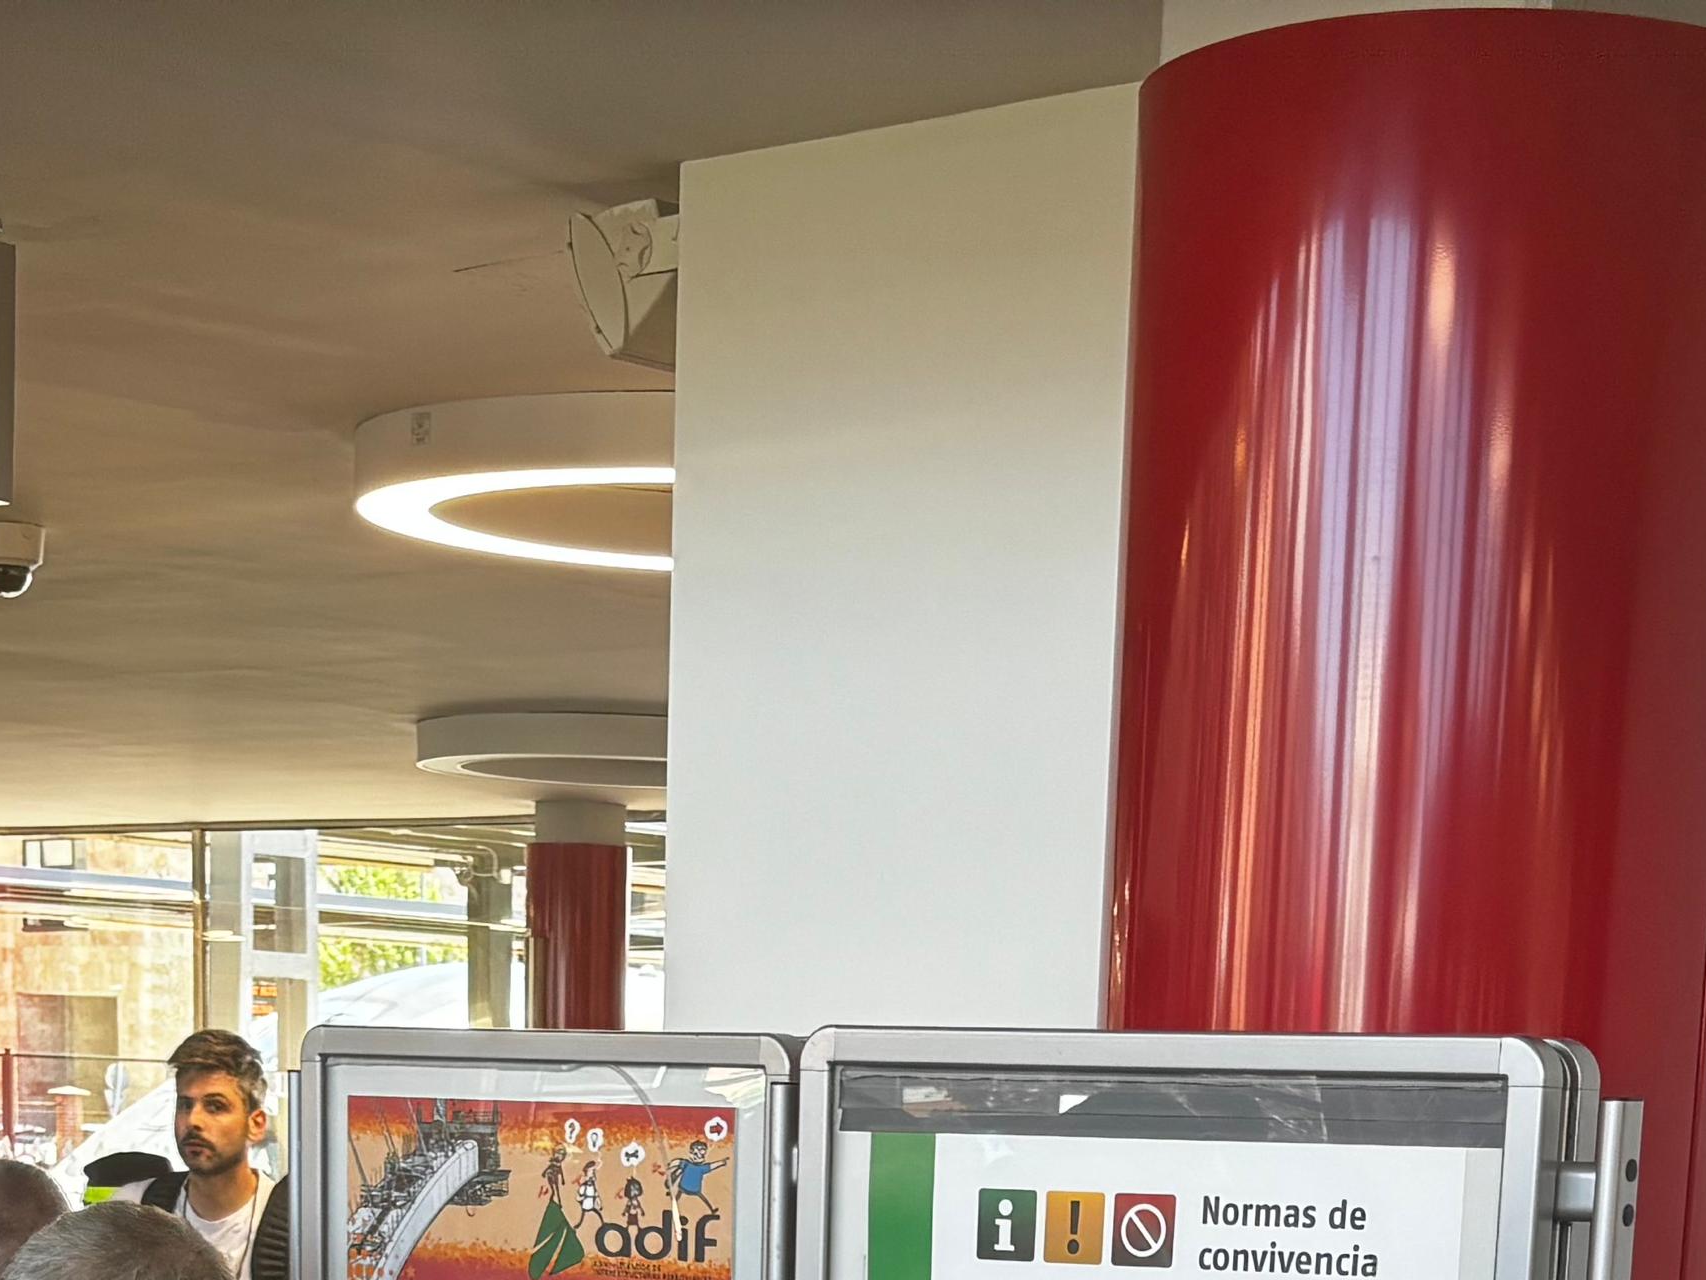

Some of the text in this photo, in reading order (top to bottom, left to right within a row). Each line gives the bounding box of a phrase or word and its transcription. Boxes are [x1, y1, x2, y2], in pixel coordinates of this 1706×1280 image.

[1201, 1195, 1367, 1230] Normas de
[594, 1209, 721, 1263] adif
[1197, 1241, 1379, 1278] convivencia
